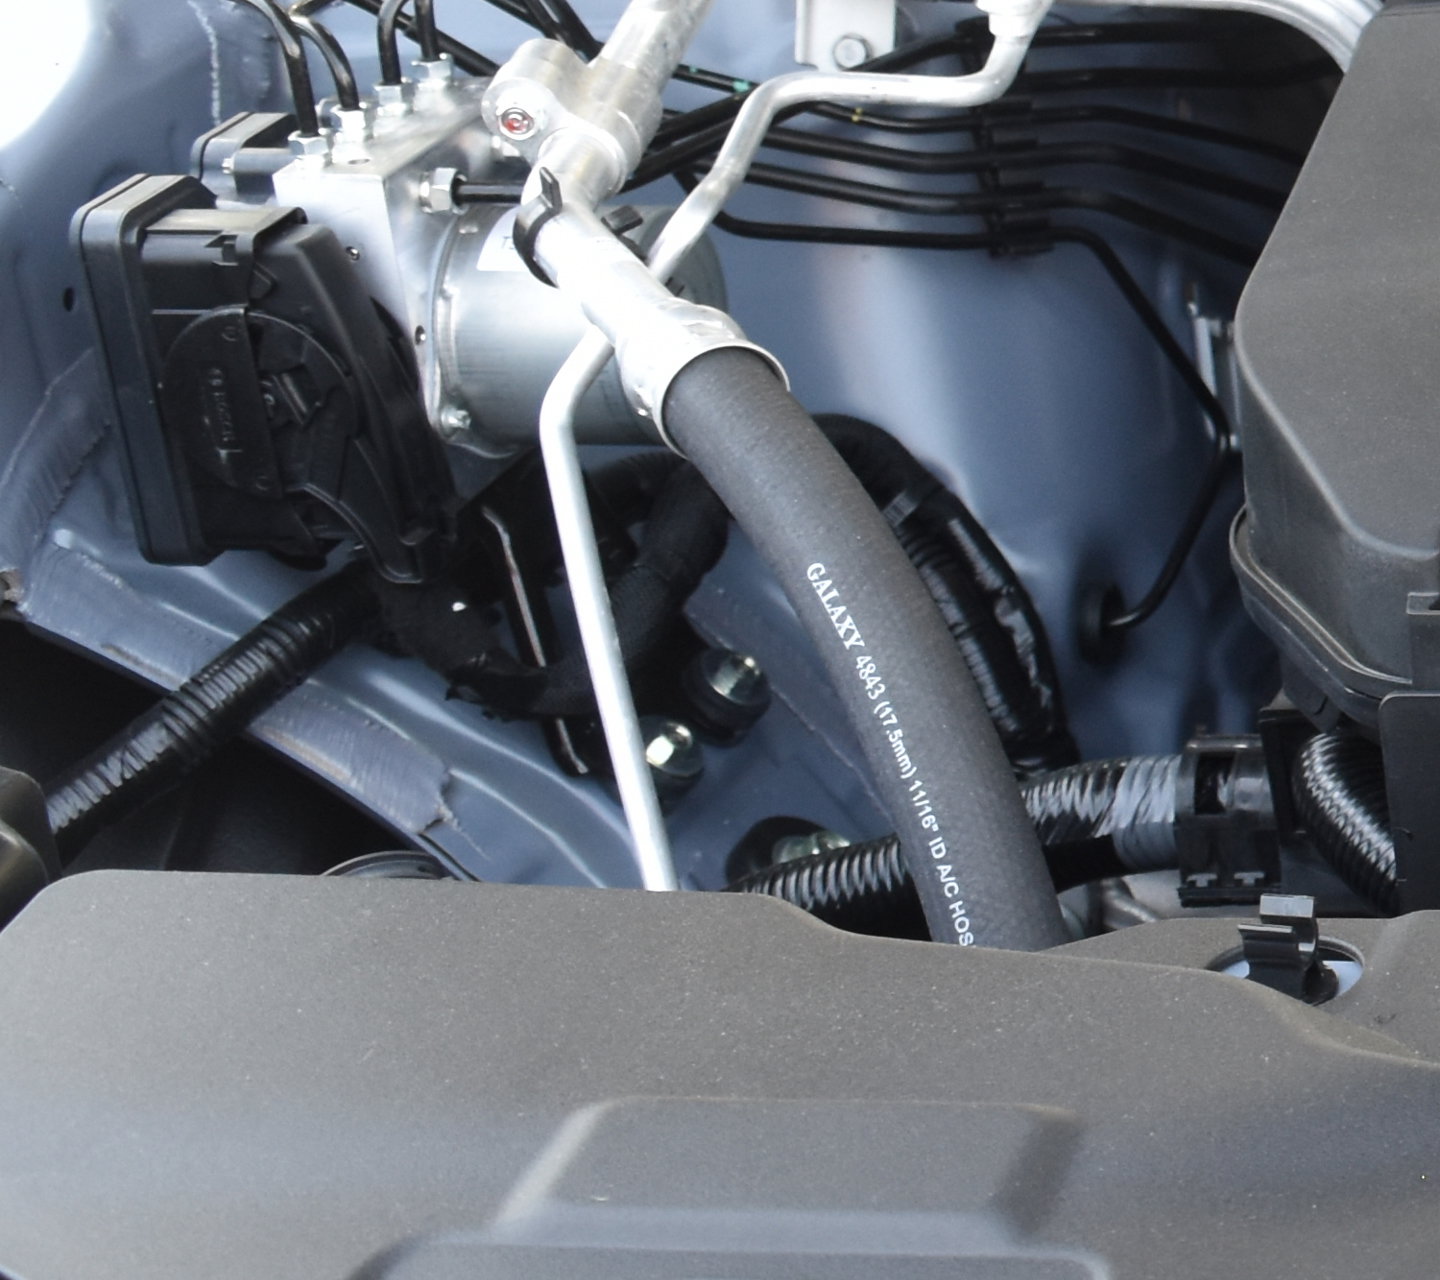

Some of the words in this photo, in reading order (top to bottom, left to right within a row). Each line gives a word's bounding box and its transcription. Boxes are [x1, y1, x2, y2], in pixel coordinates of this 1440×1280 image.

[806, 562, 866, 650] GALAXY
[855, 655, 886, 700] 4843
[873, 700, 918, 780] (17.5mm)
[908, 779, 939, 833] 11/16"
[928, 836, 947, 859] ID
[936, 864, 960, 898] A/C
[948, 900, 977, 947] HOS
